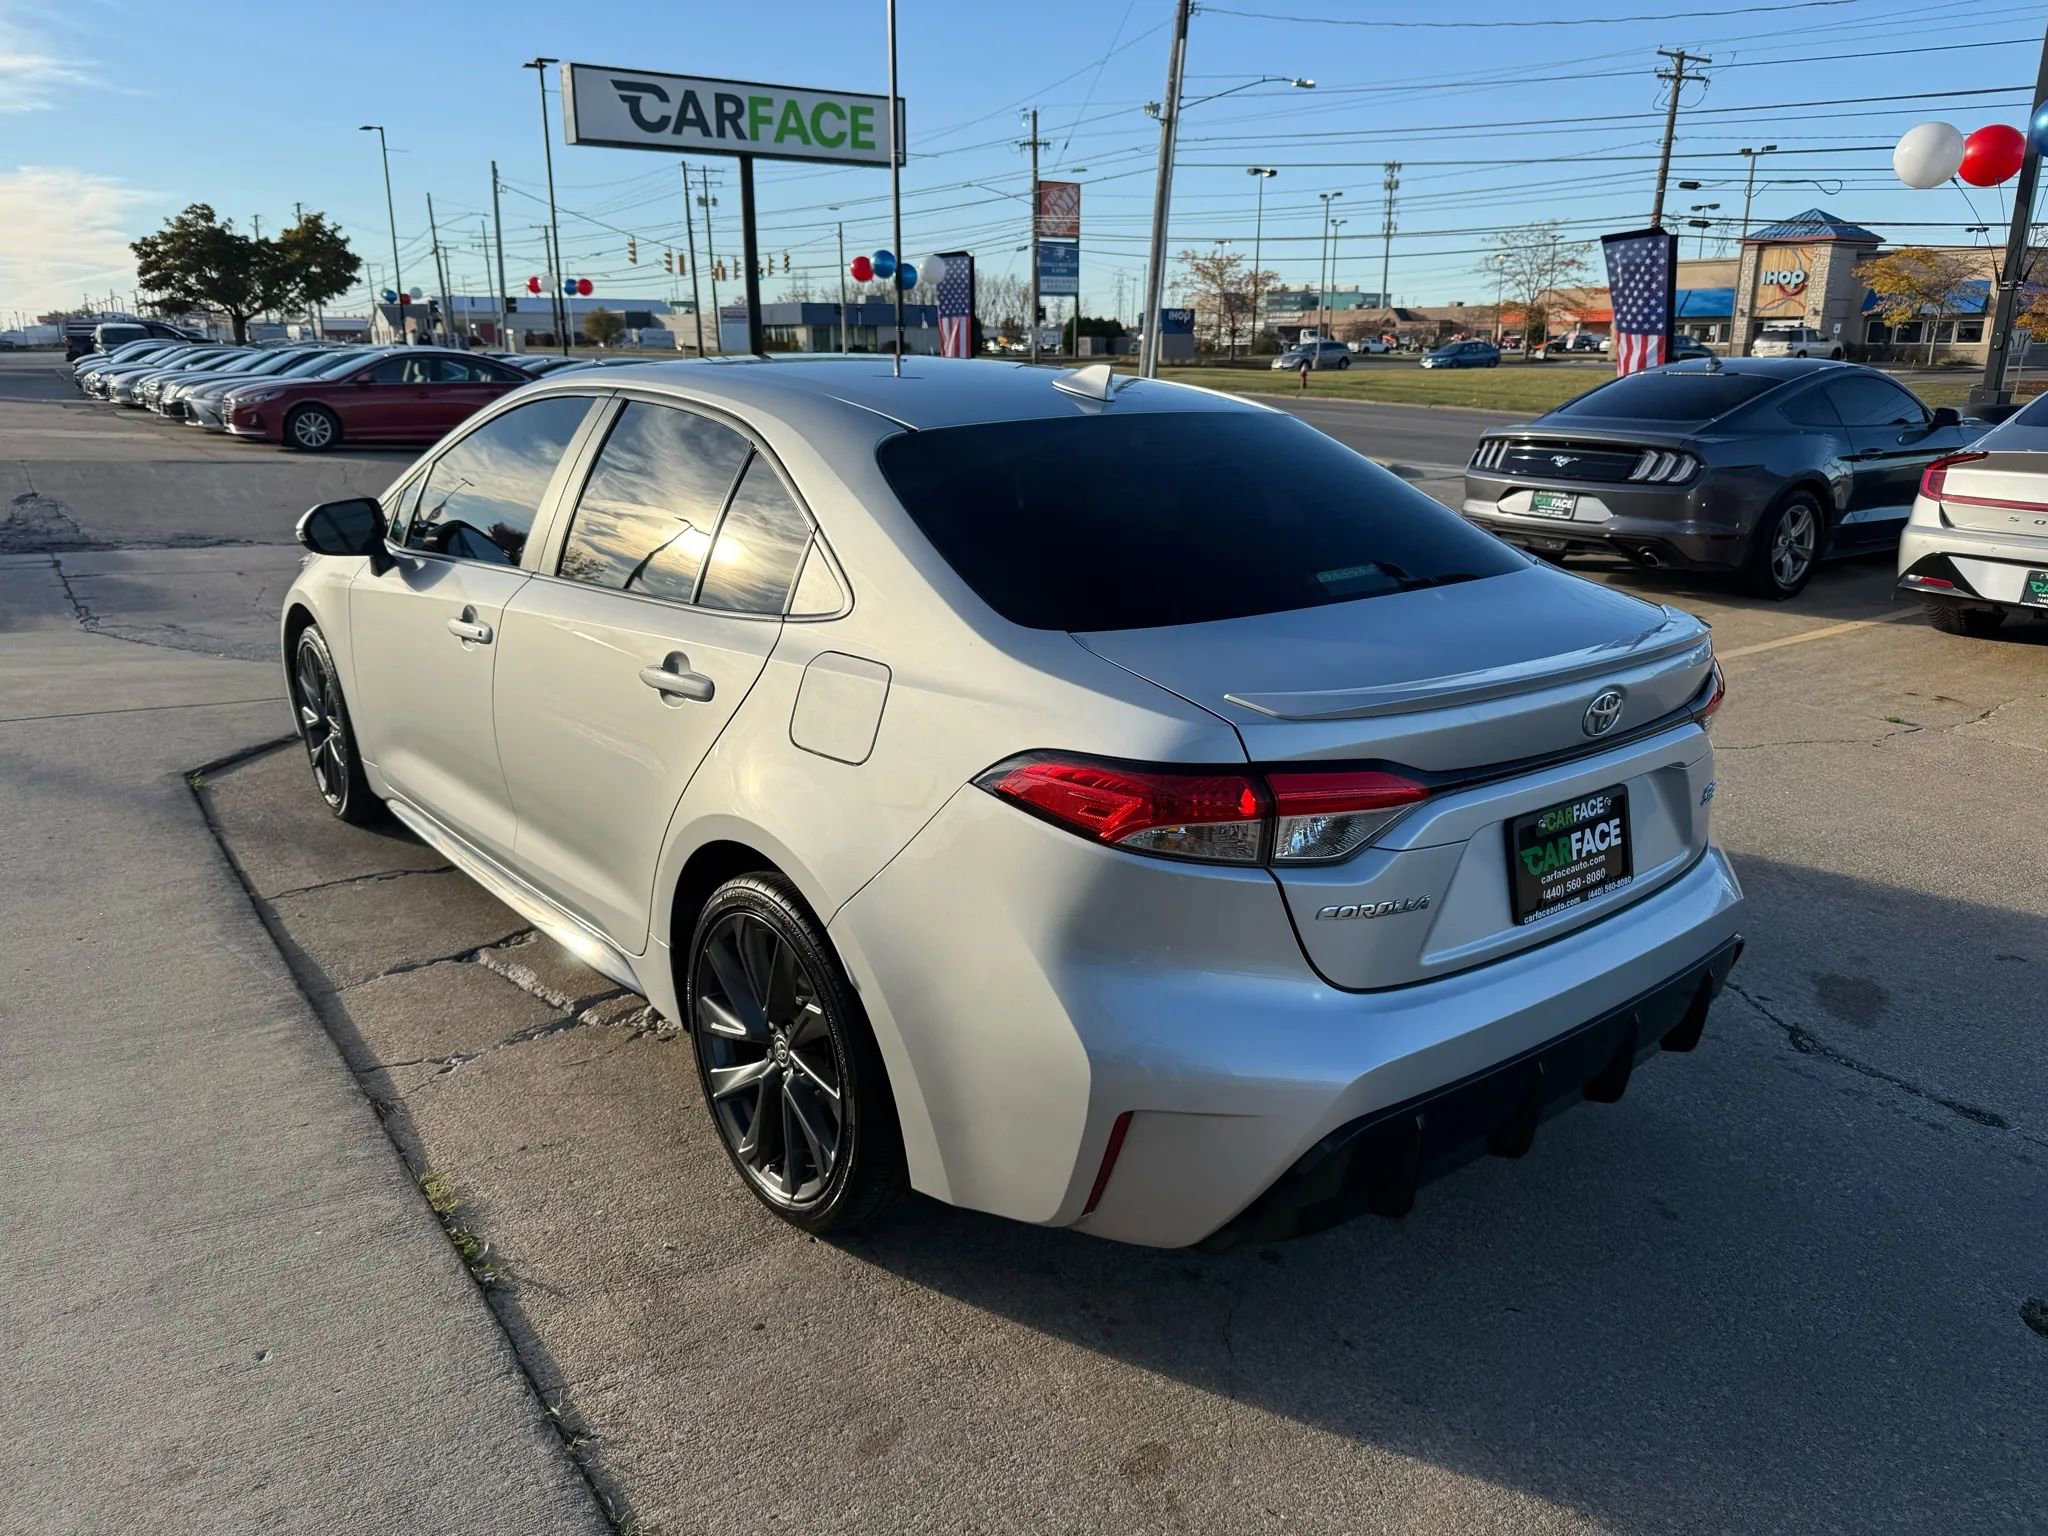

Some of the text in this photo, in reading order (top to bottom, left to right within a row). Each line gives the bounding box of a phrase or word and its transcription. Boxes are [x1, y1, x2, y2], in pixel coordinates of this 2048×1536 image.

[610, 79, 876, 150] CARFACE
[1543, 797, 1605, 832] CARFACE
[1520, 818, 1622, 876] CARFACE
[1541, 854, 1606, 884] carfaceauto.com
[1543, 884, 1564, 900] (440)
